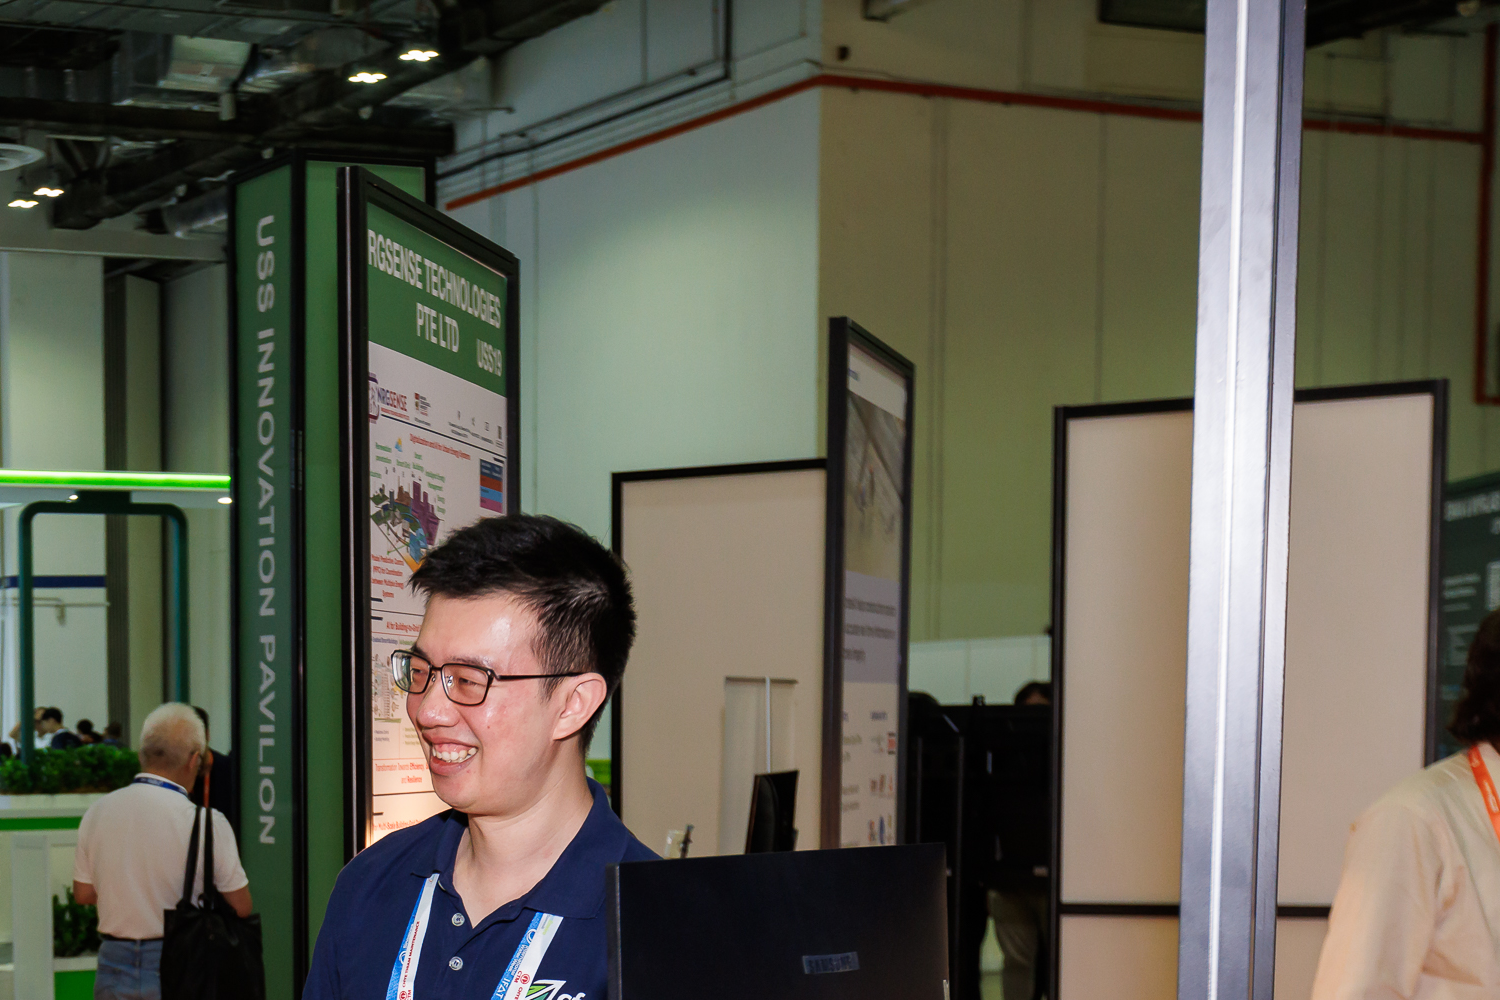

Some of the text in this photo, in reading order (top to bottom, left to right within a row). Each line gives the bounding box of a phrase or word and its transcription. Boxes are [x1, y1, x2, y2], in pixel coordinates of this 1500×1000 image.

[415, 301, 460, 353] PTE LTD
[424, 258, 501, 329] TECHNOLOGIES
[256, 214, 276, 845] USS INNOVATION PAVILION
